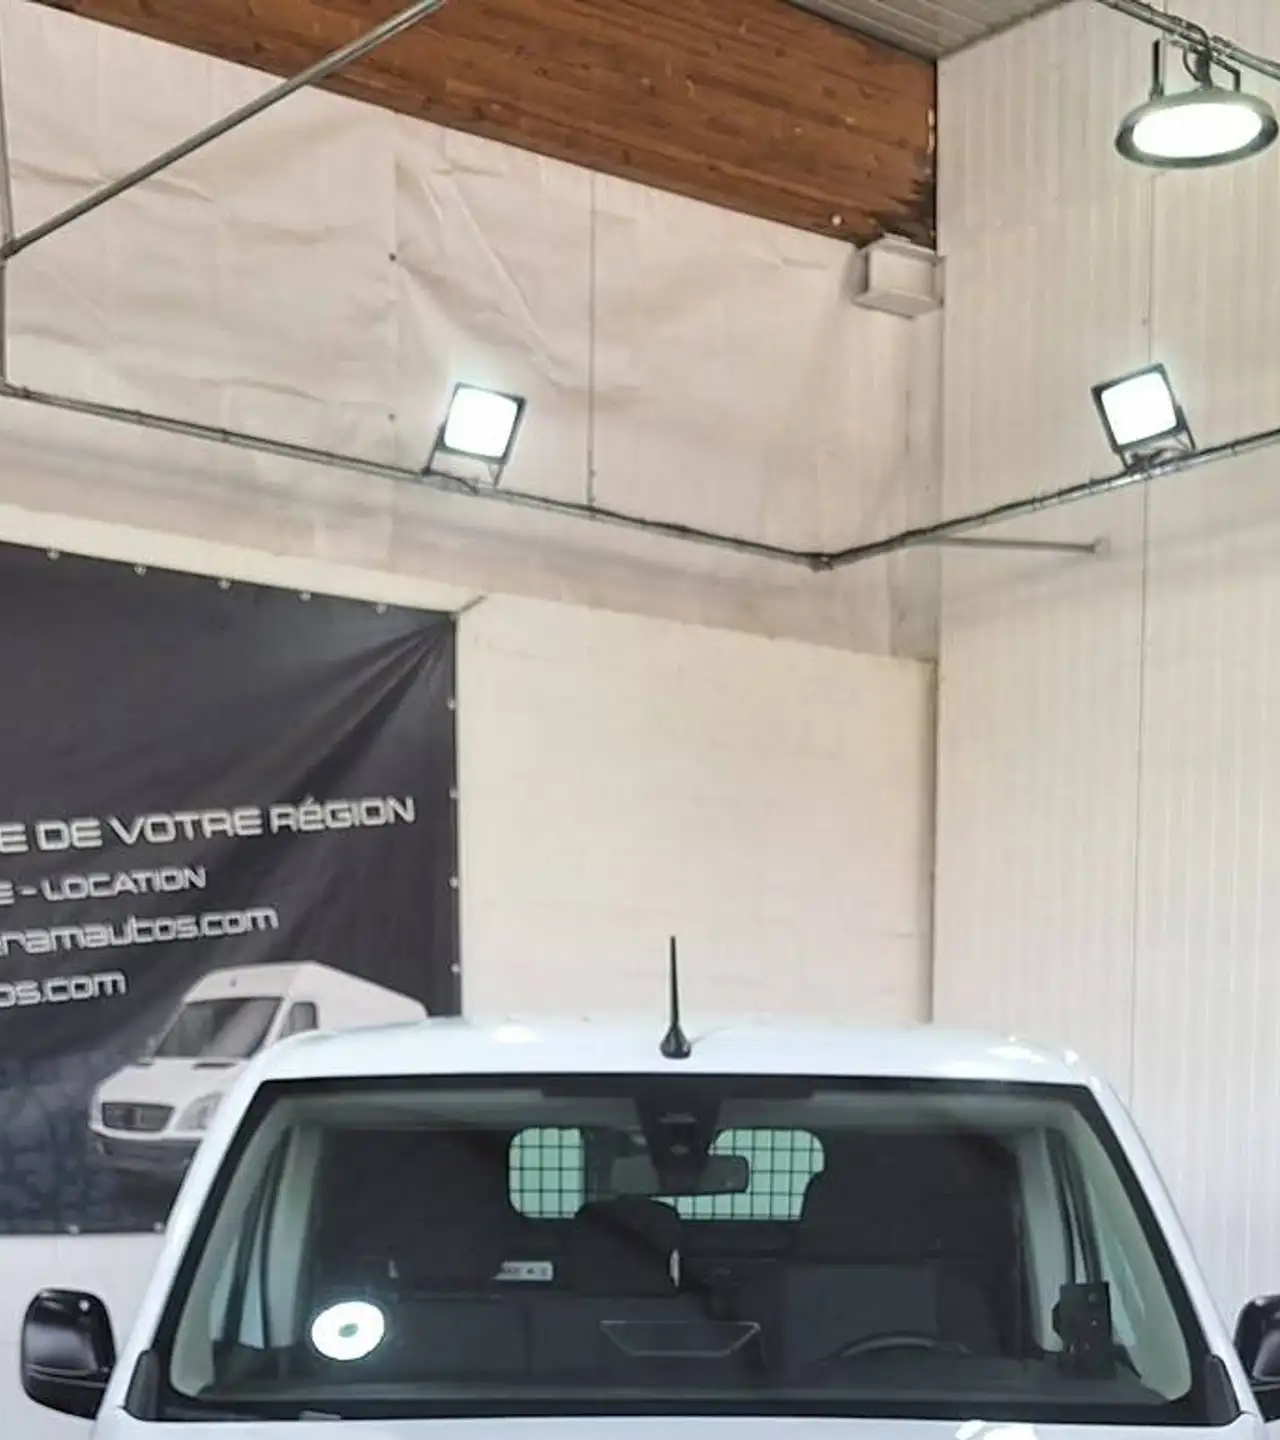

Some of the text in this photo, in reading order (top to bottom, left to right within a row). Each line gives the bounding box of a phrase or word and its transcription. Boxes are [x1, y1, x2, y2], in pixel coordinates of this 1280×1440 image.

[36, 817, 104, 851] DE
[110, 804, 264, 846] VOTRE
[269, 796, 417, 834] RÉGION
[42, 865, 208, 903] LOCATION
